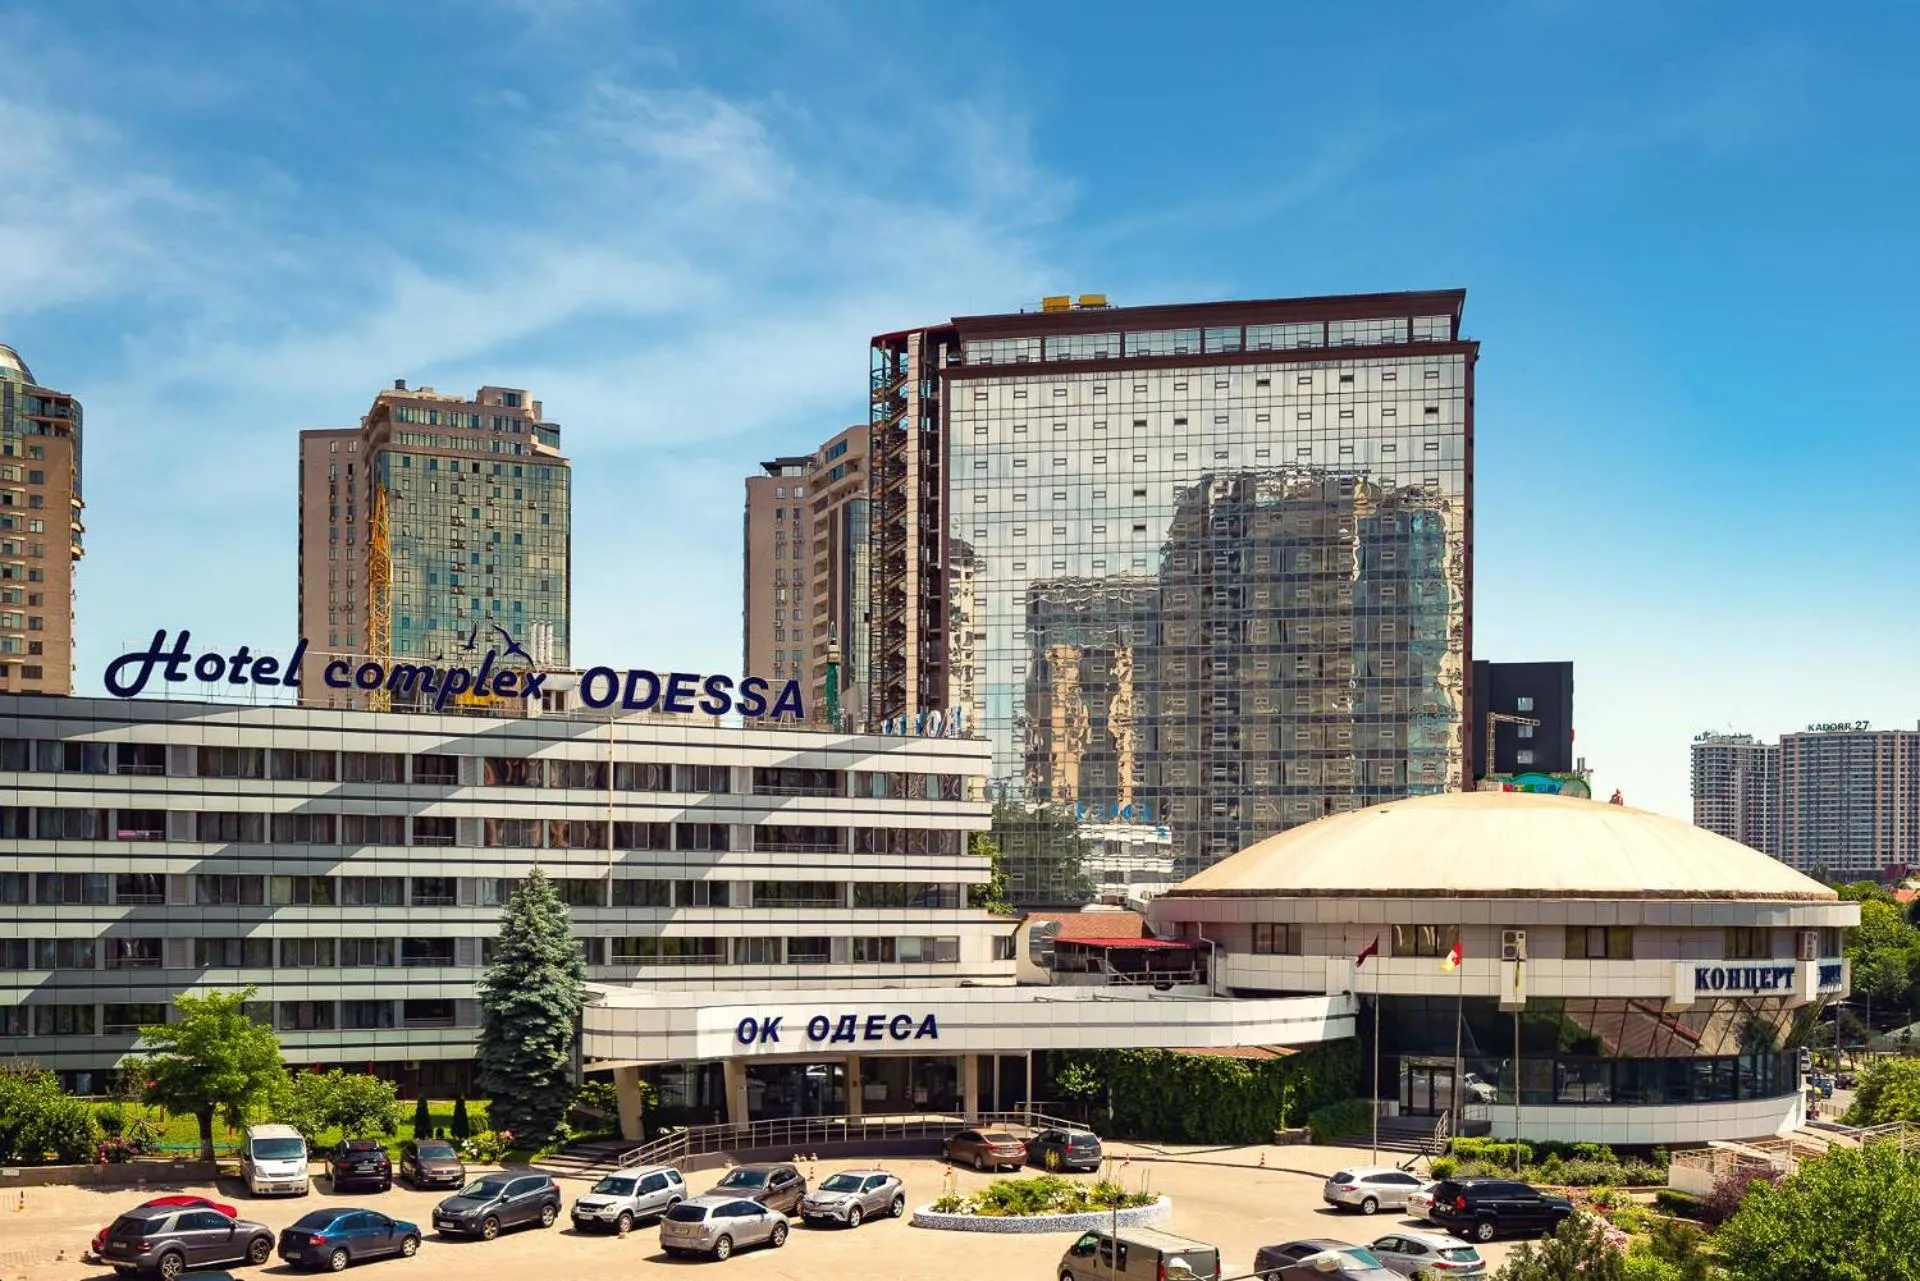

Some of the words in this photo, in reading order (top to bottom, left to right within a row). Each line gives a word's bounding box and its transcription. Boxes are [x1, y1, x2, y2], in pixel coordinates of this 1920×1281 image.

[104, 629, 309, 698] Hotel
[324, 649, 547, 711] complex
[580, 665, 805, 719] ODESSA
[1855, 720, 1870, 731] 27
[1695, 966, 1795, 993] КОНЦЕРТ
[736, 1016, 783, 1044] ОК
[806, 1014, 938, 1044] ОДЕСА
